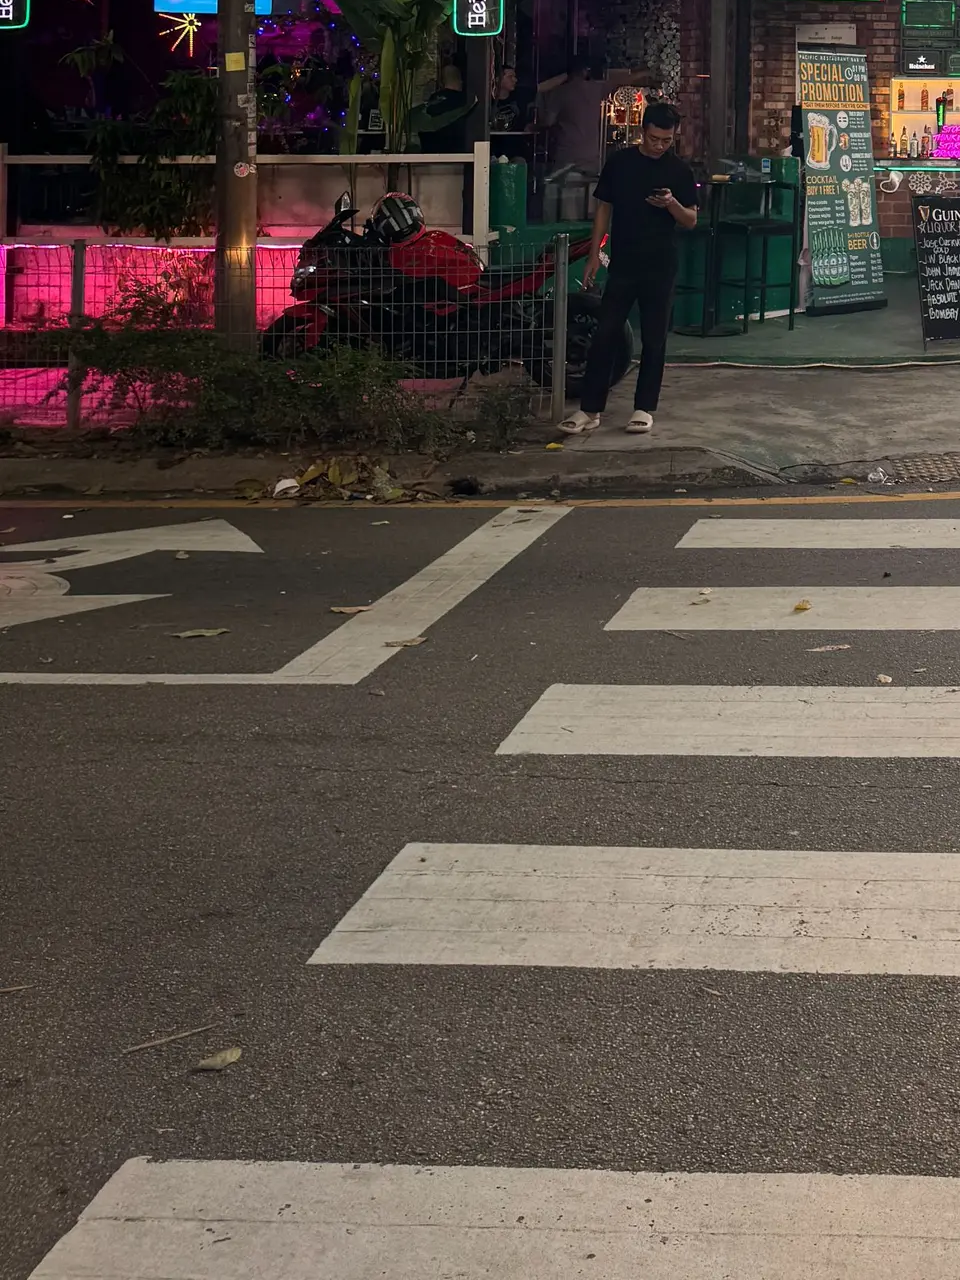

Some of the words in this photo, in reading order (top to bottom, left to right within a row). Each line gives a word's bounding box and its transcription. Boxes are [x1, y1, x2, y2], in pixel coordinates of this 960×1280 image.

[800, 62, 845, 82] SPECIAL
[801, 82, 864, 102] PROMOTION
[806, 175, 839, 184] COCKTAIL
[807, 186, 818, 195] BUY
[823, 185, 836, 195] FREE
[927, 221, 955, 233] LIQUOR
[848, 240, 867, 250] BEER
[925, 278, 945, 292] JACK
[928, 307, 959, 321] BOMBAY
